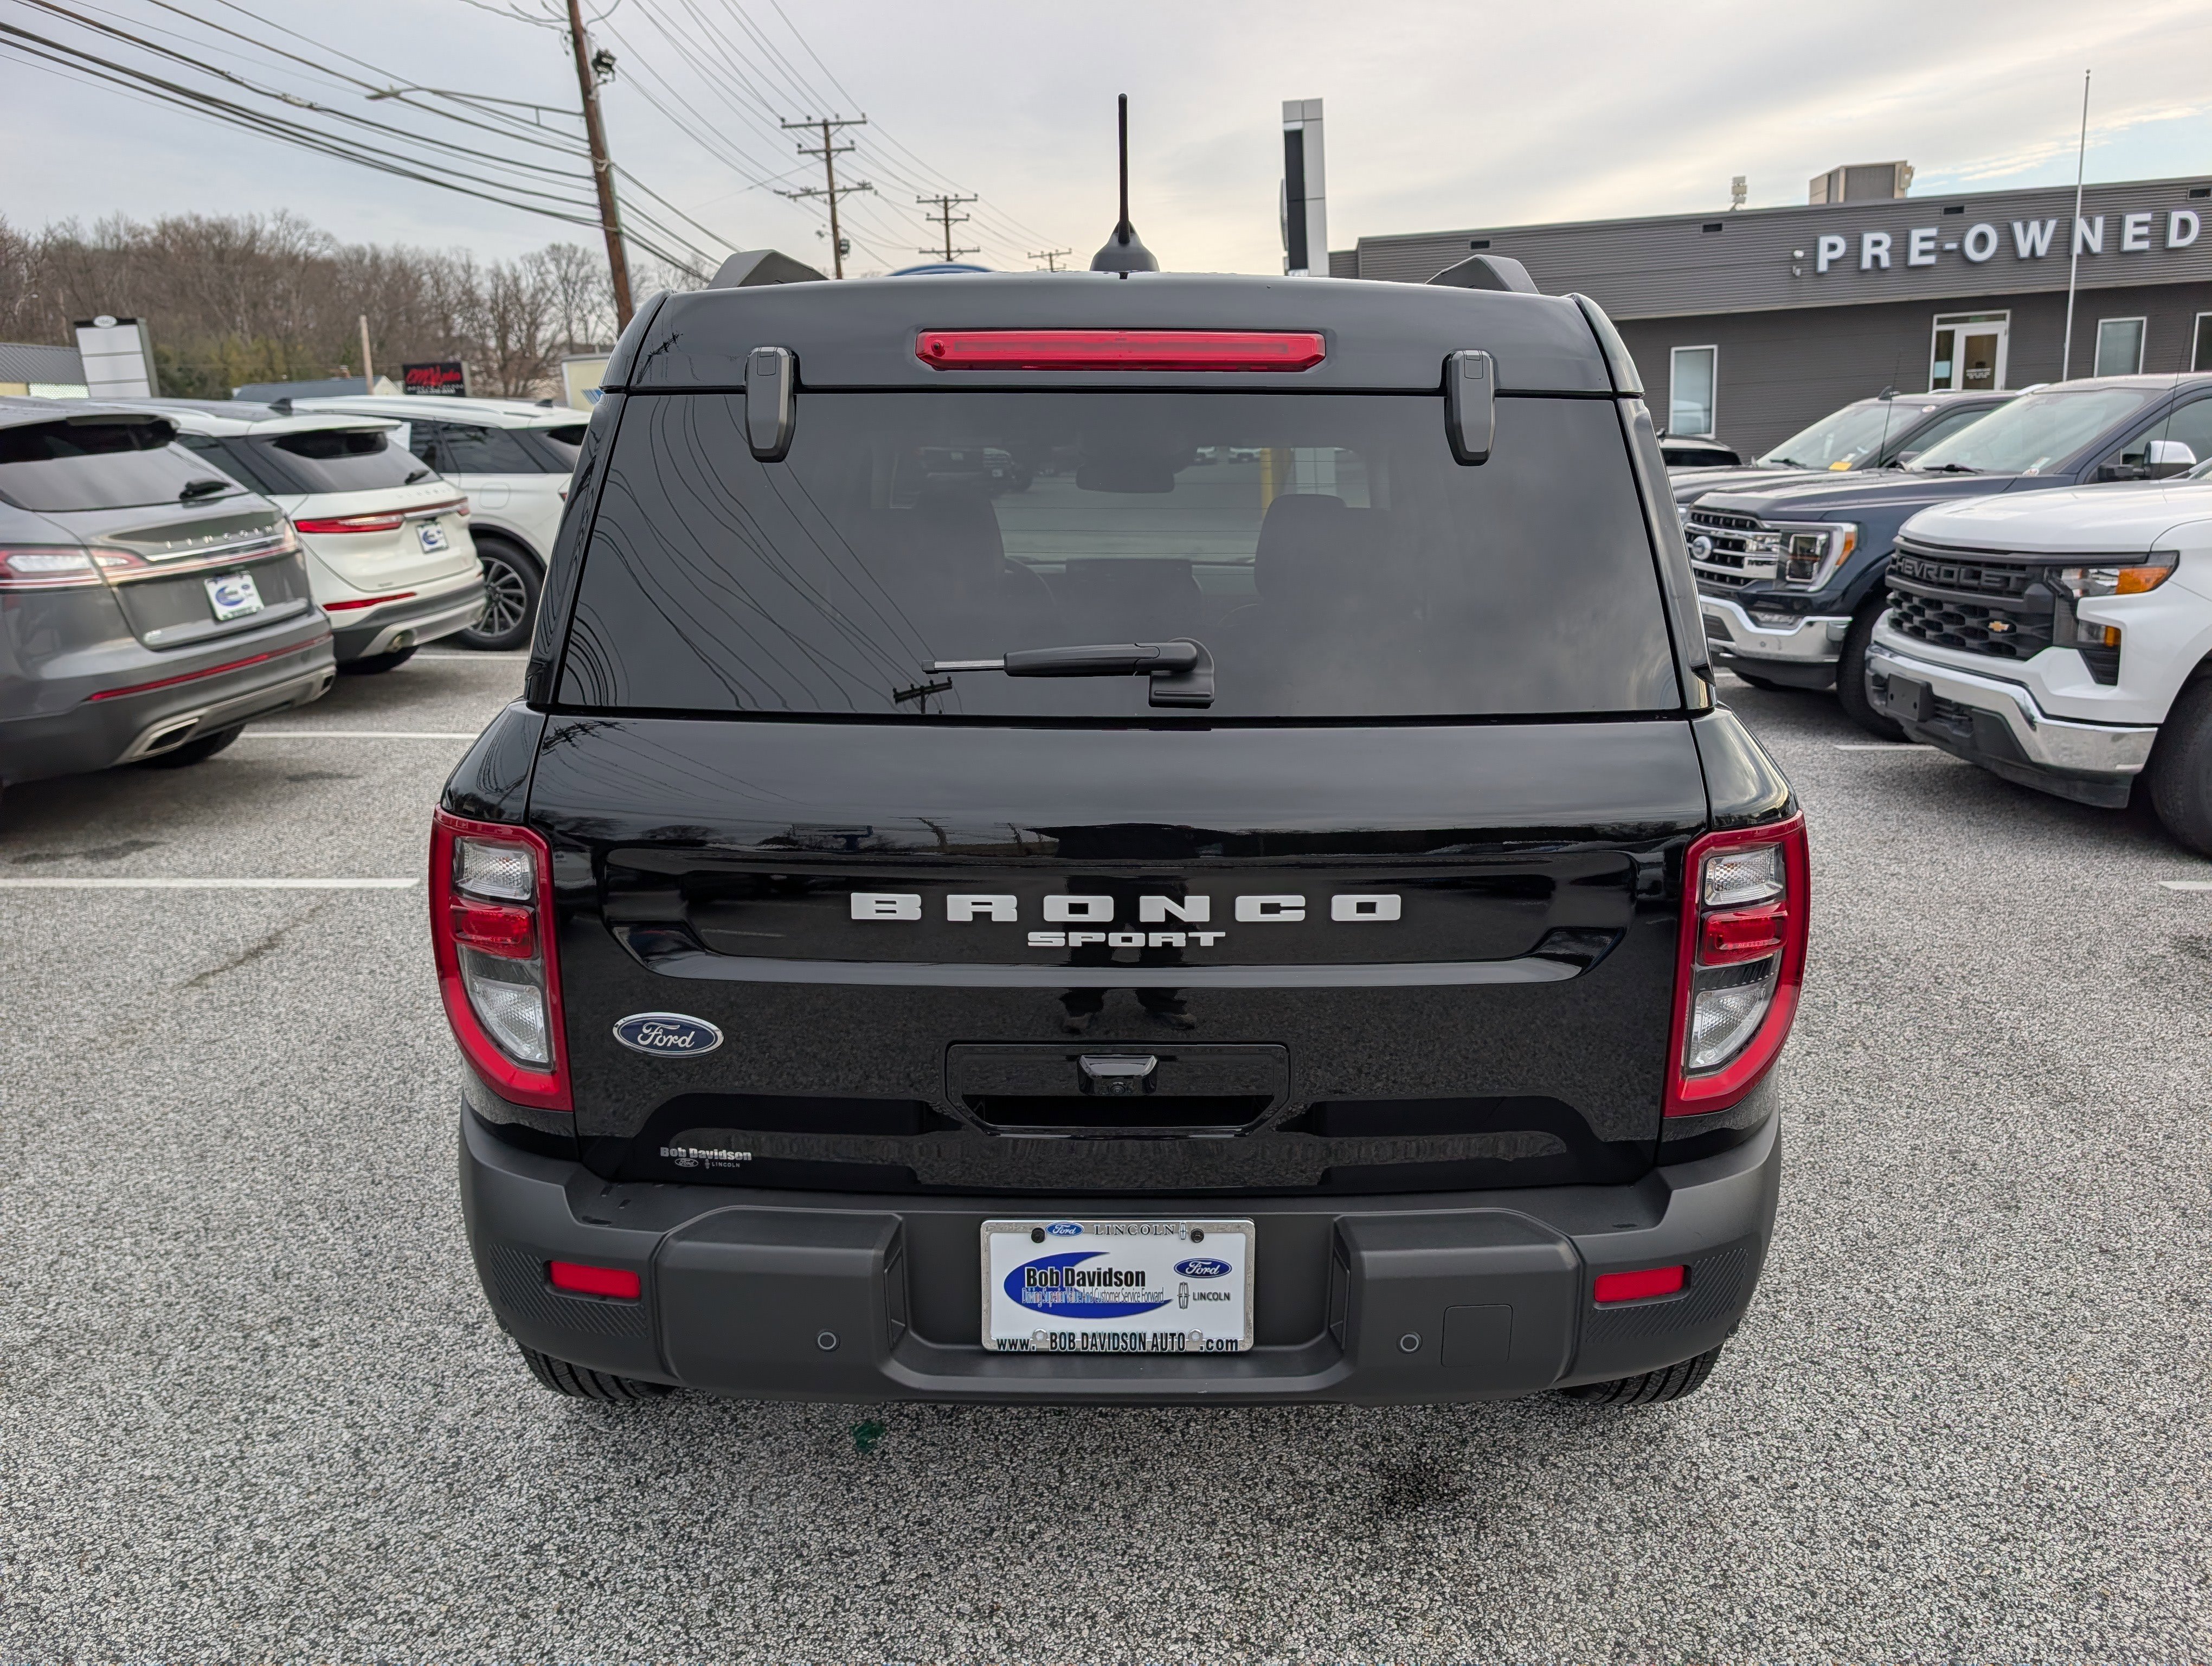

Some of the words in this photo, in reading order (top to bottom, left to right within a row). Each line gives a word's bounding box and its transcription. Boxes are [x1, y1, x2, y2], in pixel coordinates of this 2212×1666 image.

[1817, 210, 2201, 272] PRE-OWNED
[851, 892, 1401, 922] BRONCO
[1027, 932, 1226, 947] SPORT
[638, 1022, 695, 1048] Ford
[660, 1147, 686, 1157] Bob
[689, 1148, 752, 1161] Davidson
[1053, 1223, 1077, 1235] Ford
[1094, 1223, 1175, 1235] LINCOLN
[1025, 1267, 1060, 1287] Bob
[1063, 1267, 1146, 1287] Davidson
[1185, 1261, 1220, 1274] Ford
[1022, 1287, 1042, 1308] Driving
[1094, 1287, 1121, 1303] Customer
[1121, 1287, 1141, 1303] Service
[1141, 1287, 1164, 1303] Forward
[1193, 1292, 1230, 1300] LINCOLN
[996, 1337, 1036, 1350] www.
[1050, 1333, 1076, 1351] BOB
[1081, 1332, 1146, 1351] DAVIDSON
[1150, 1332, 1186, 1351] AUTO
[1199, 1337, 1238, 1351] .com
